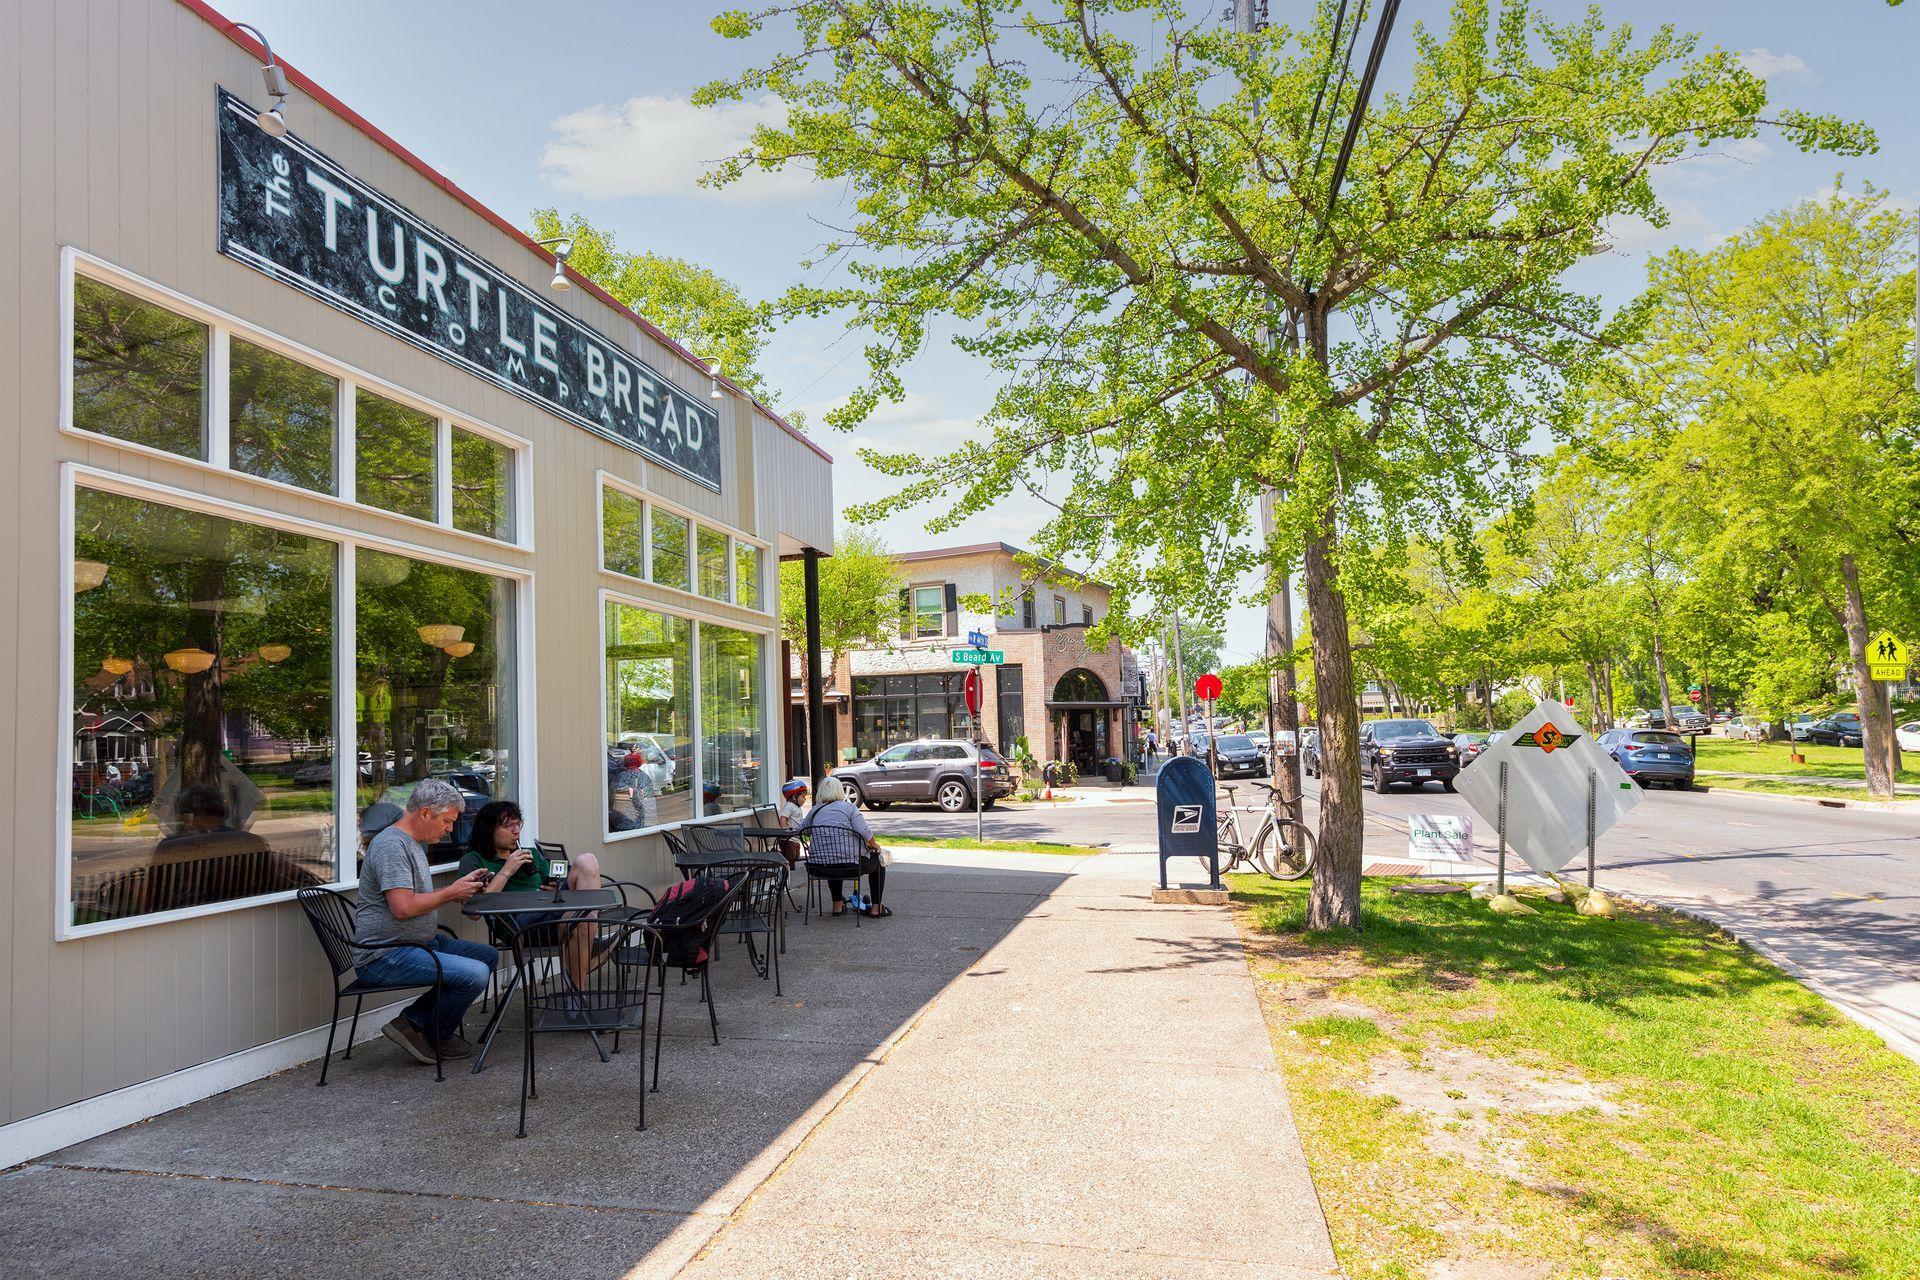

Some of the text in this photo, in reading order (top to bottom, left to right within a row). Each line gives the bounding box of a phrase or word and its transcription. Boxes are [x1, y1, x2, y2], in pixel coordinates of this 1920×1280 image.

[265, 152, 291, 217] The
[305, 167, 703, 450] TURTLE BREAD
[955, 652, 1001, 662] S Beard Av
[1875, 669, 1901, 677] AHEAD
[1414, 829, 1469, 840] Plant Sale
